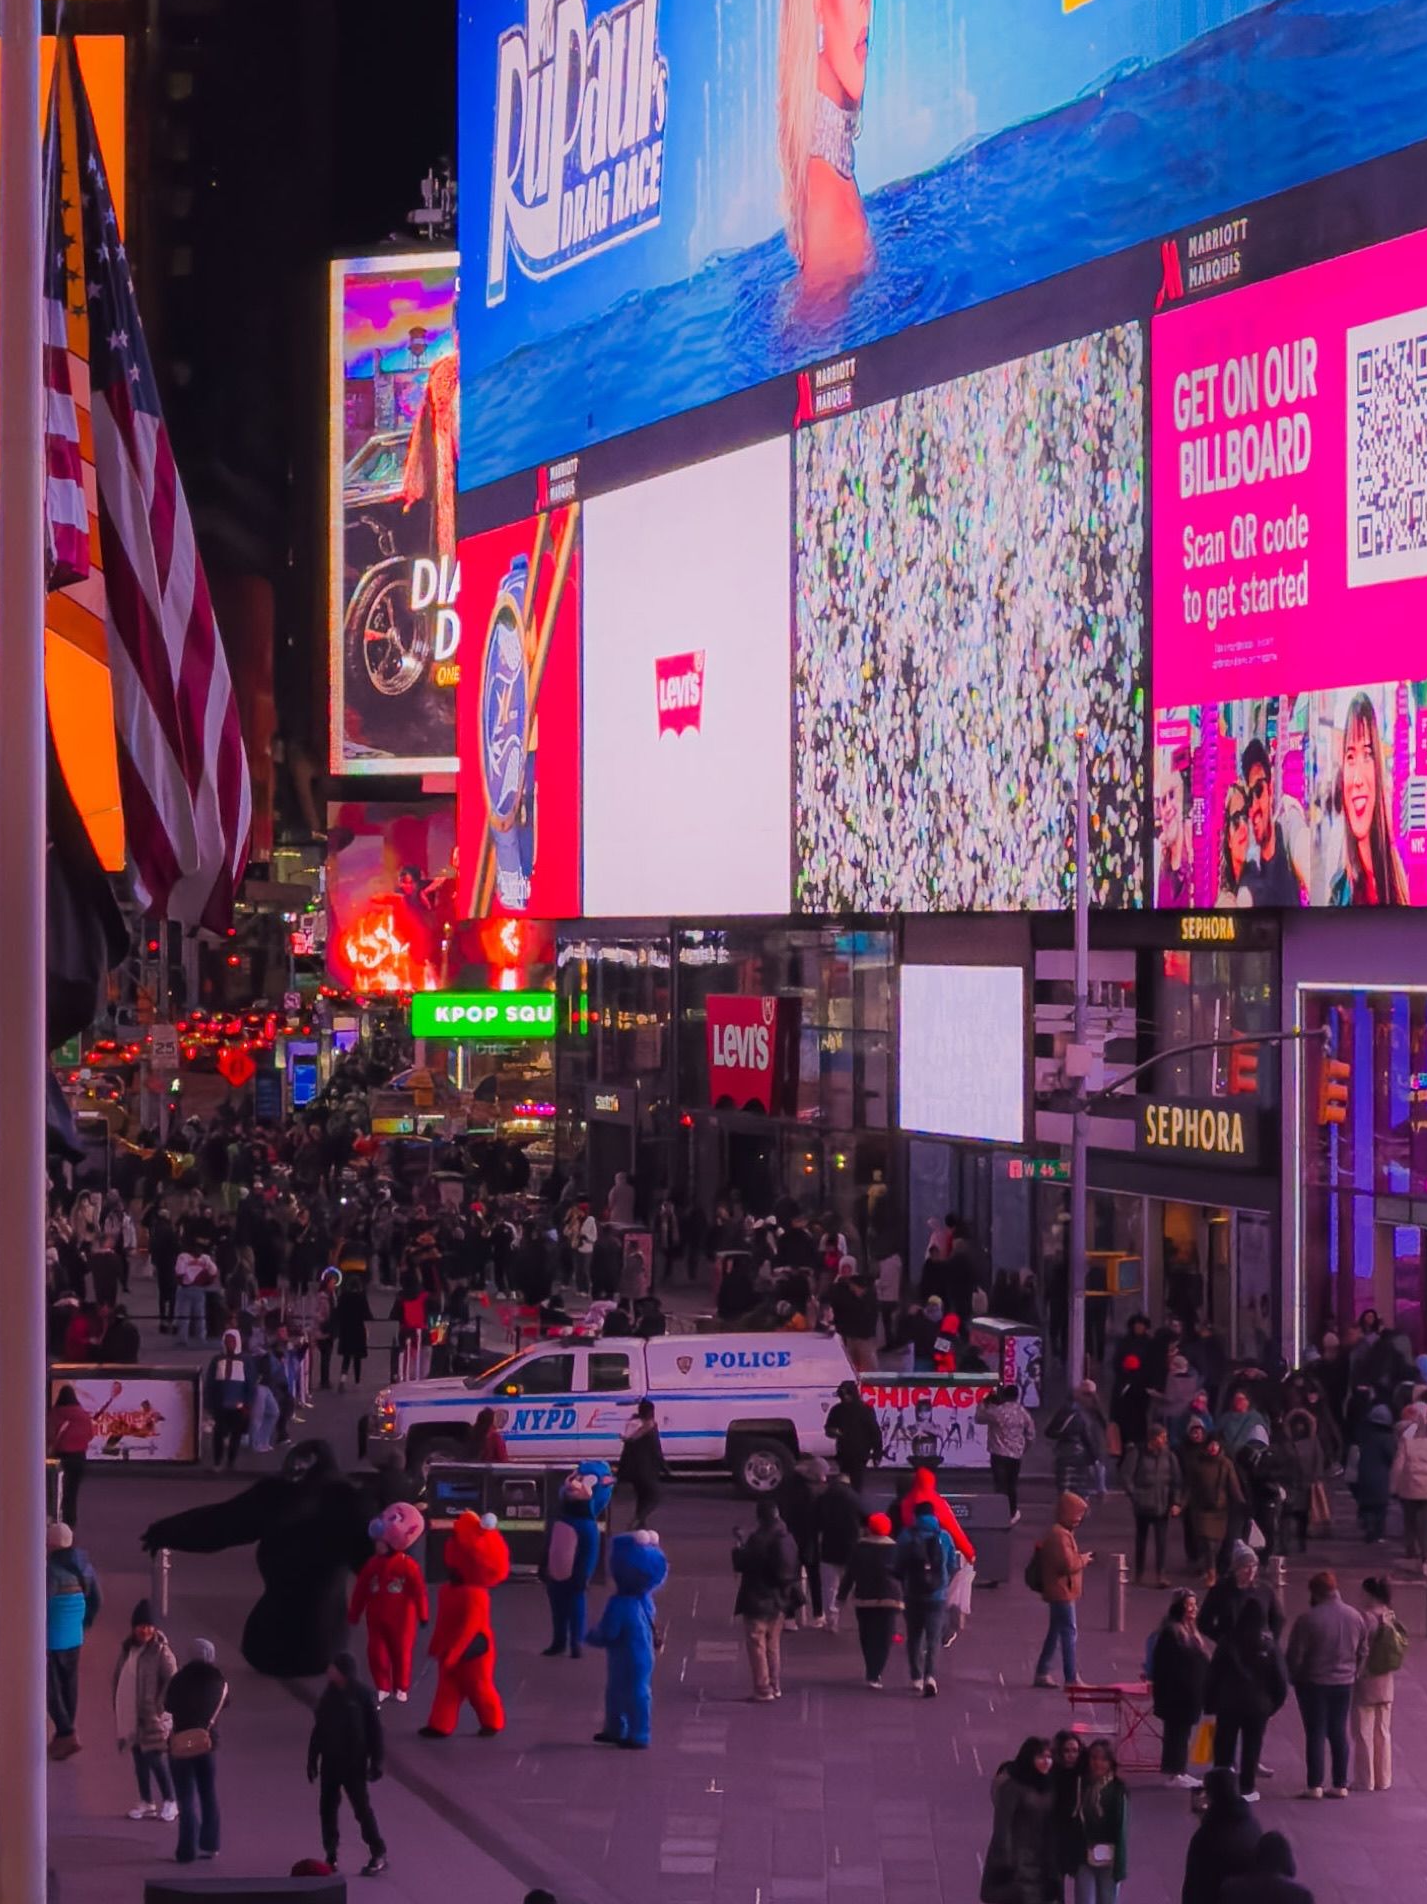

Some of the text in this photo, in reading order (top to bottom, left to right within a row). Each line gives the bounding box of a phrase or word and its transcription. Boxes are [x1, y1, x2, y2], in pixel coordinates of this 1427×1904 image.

[560, 141, 664, 252] DRAG RACE
[1189, 218, 1248, 258] MARRIOTT
[1188, 251, 1241, 289] MARQUIS
[815, 357, 856, 388] MARRIOTT
[1173, 336, 1319, 432] GET ON OUR
[815, 385, 852, 412] MARQUIS
[1179, 411, 1312, 500] BILLBOARD
[1182, 503, 1309, 571] Scan QR code
[1182, 559, 1309, 632] to get started
[1180, 917, 1236, 940] SEPHORA
[435, 1005, 553, 1023] KPOP SQU
[1146, 1104, 1245, 1154] SEPHORA
[704, 1350, 791, 1370] POLICE
[859, 1385, 999, 1410] CHICAGO
[511, 1407, 577, 1431] NYPD
